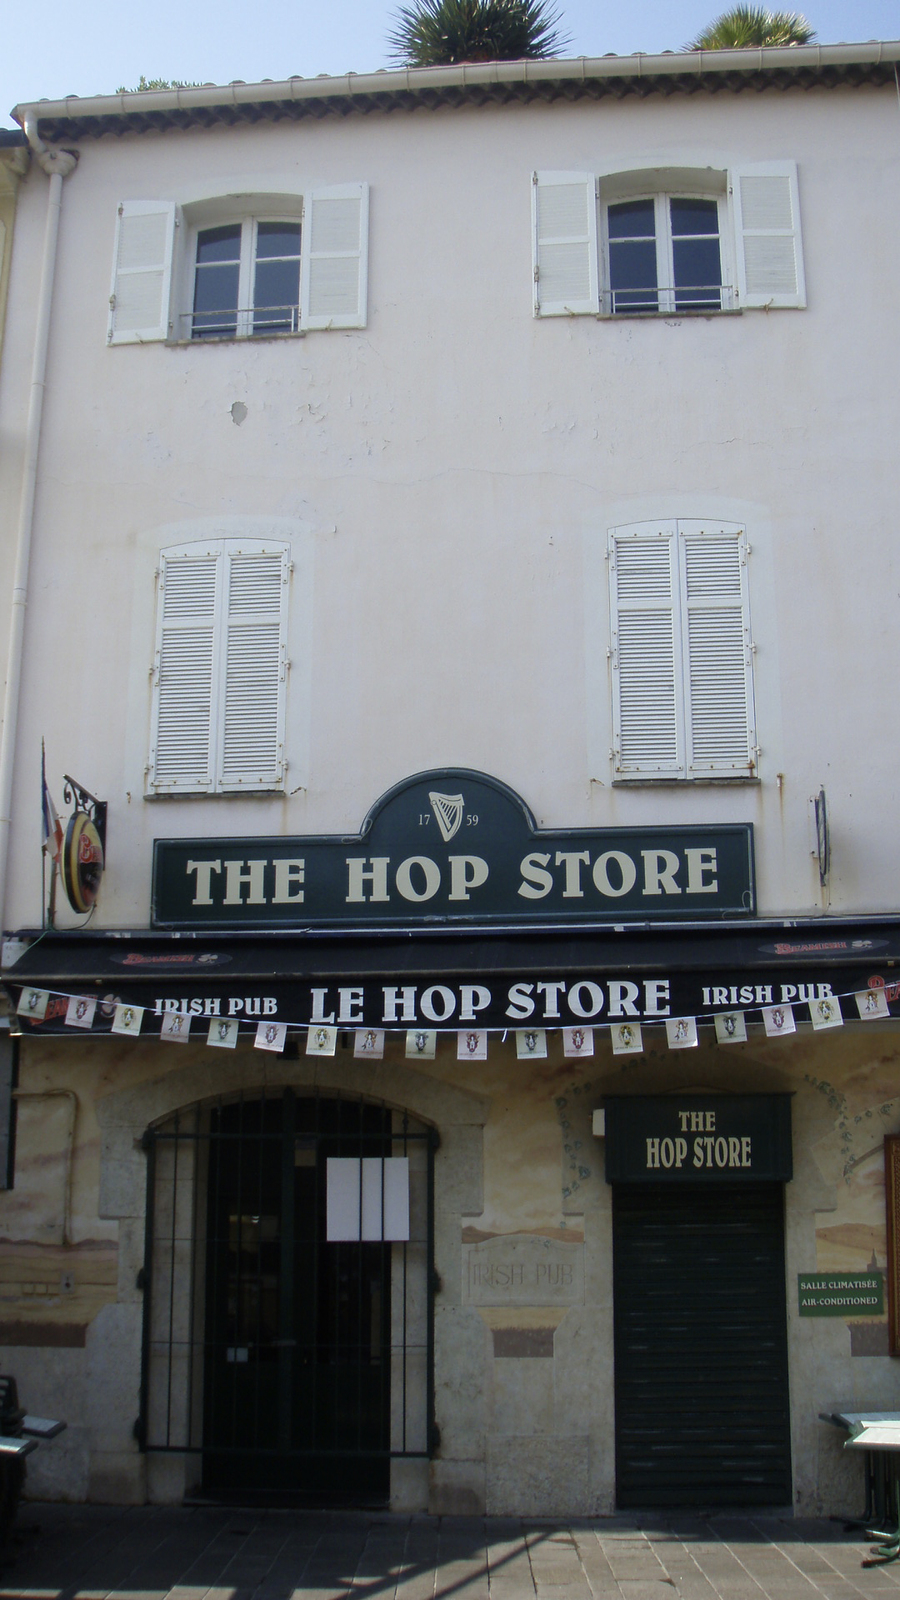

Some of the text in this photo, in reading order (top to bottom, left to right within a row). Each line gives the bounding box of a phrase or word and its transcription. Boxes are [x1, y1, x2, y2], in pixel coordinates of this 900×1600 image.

[419, 814, 479, 826] 17 59
[186, 847, 718, 905] THE HOP STORE
[309, 979, 671, 1024] LE HOP STORE
[702, 983, 833, 1005] IRISH PUB
[154, 997, 278, 1016] IRISH PUB
[678, 1111, 716, 1132] THE
[645, 1136, 752, 1168] HOP STORE
[473, 1263, 574, 1288] IRISH PUB
[800, 1279, 878, 1290] SALLE CLIMATISÉE
[801, 1296, 878, 1306] AIR-CONDITIONED
